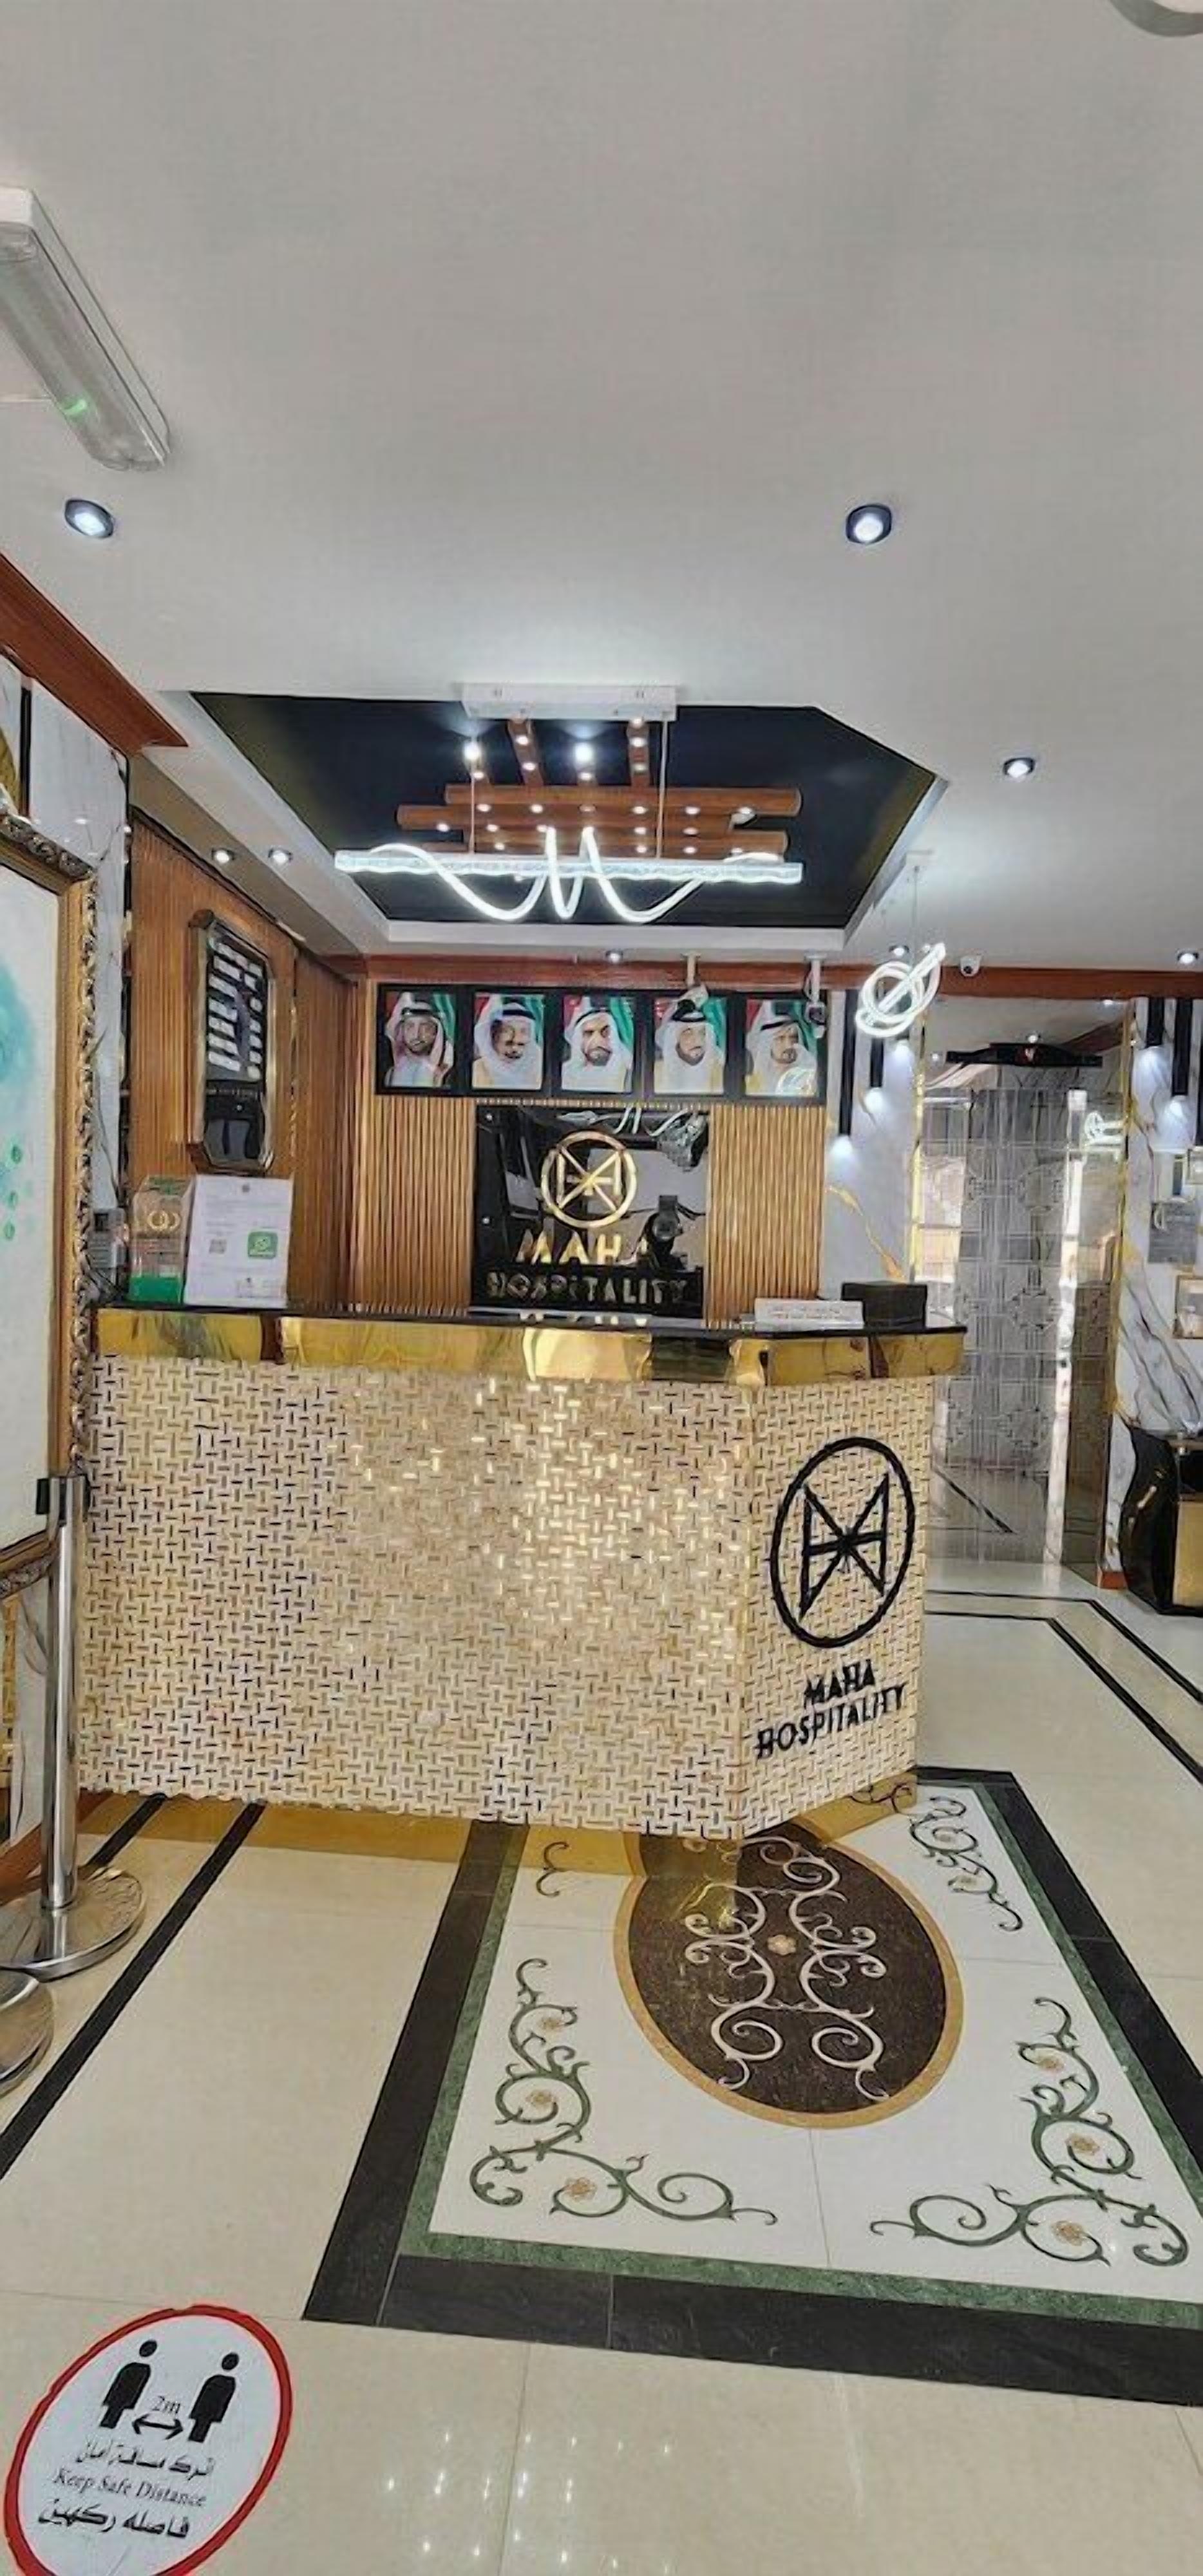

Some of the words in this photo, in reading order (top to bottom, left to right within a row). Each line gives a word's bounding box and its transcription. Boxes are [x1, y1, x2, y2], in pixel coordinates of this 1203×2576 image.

[486, 1271, 687, 1304] HOSPITALITY
[803, 1658, 875, 1710] MAHA
[756, 1682, 907, 1760] HOSPITALITY
[151, 2395, 181, 2414] 2m
[53, 2467, 95, 2494] Keep
[98, 2476, 131, 2495] Safe
[135, 2480, 207, 2507] Distance
